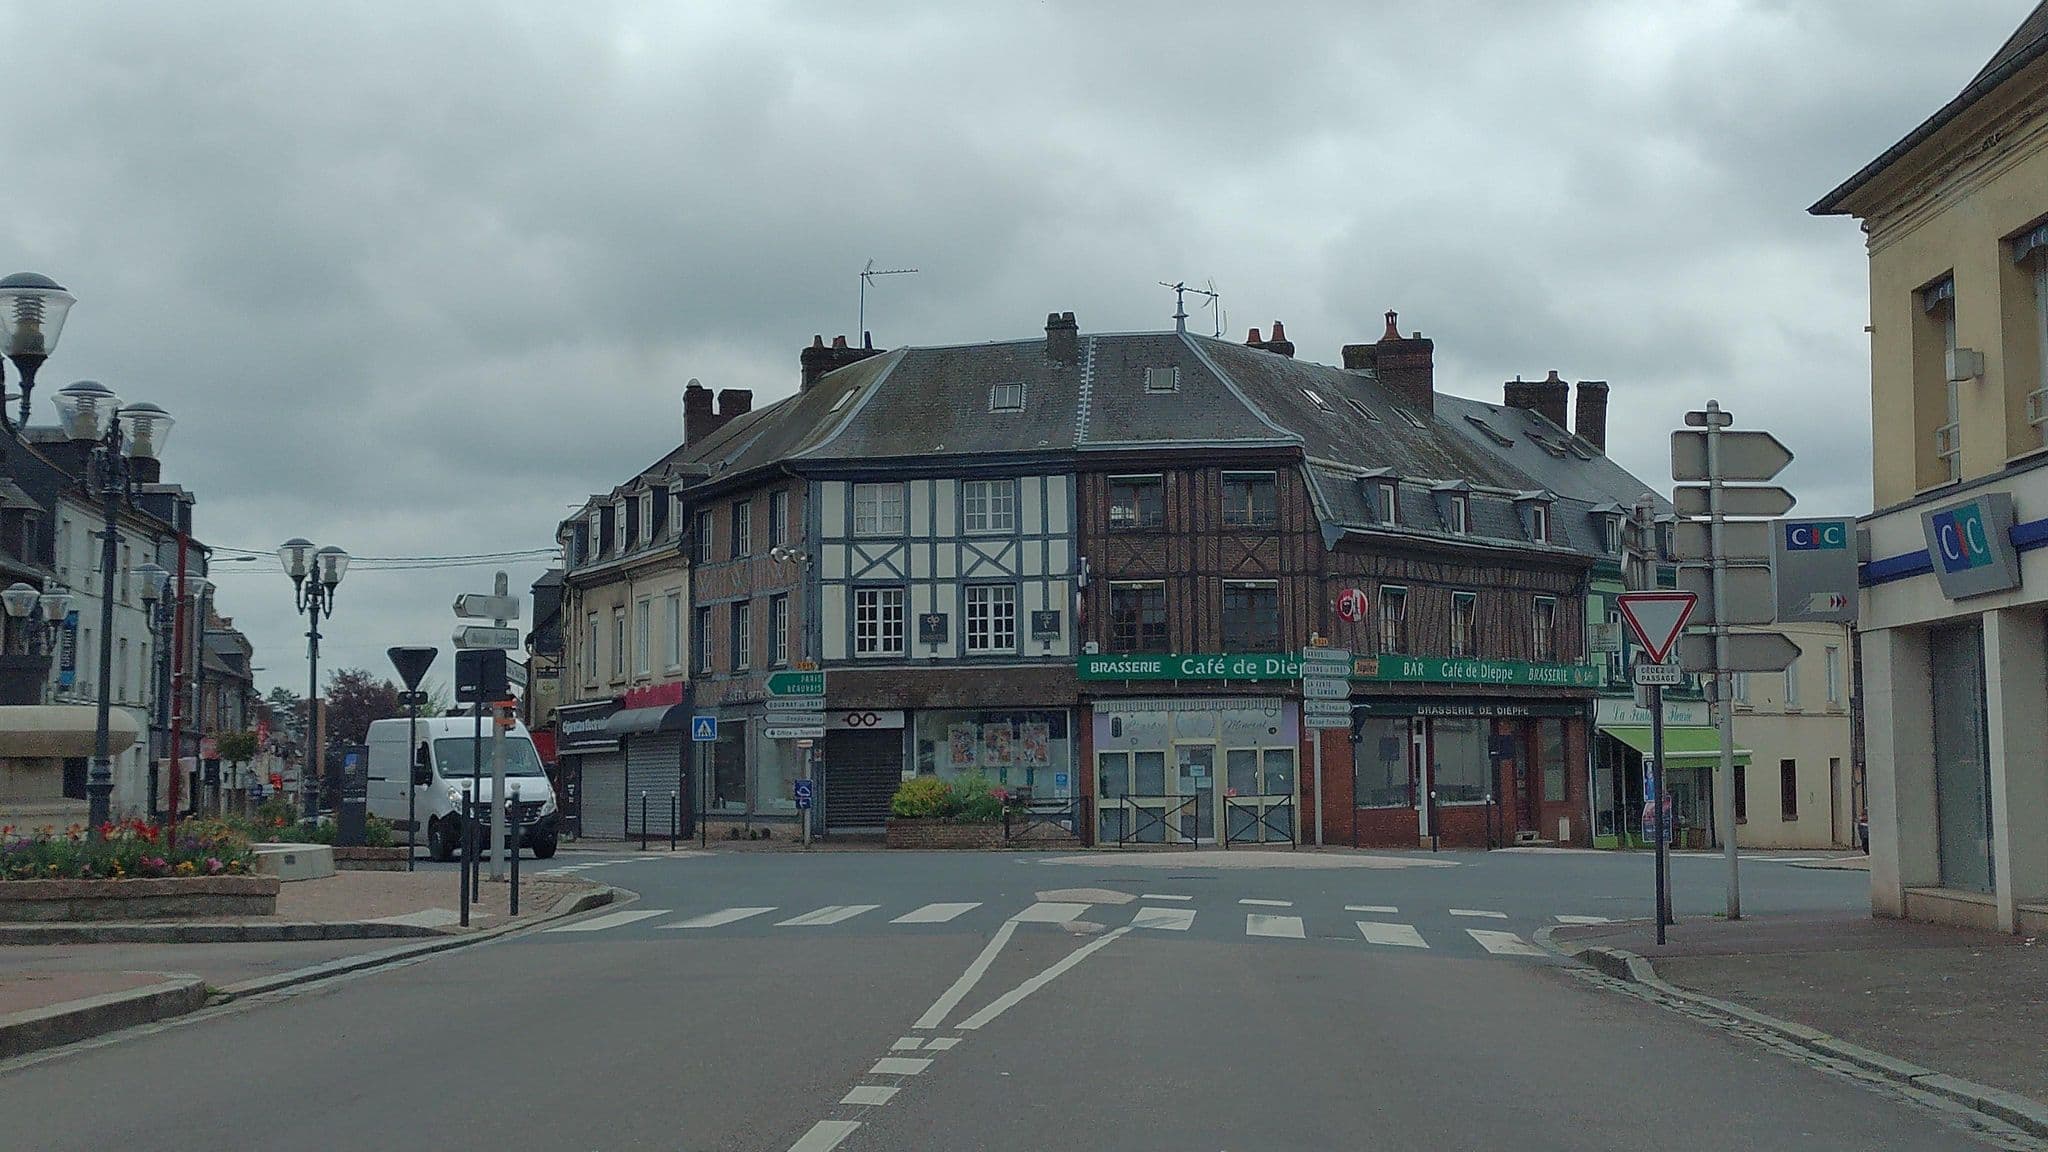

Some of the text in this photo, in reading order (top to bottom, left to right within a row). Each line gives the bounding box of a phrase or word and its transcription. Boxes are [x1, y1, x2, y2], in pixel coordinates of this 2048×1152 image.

[1791, 527, 1839, 546] CIC
[1941, 517, 1983, 560] CIC
[1090, 658, 1304, 679] BRASSERIE Café de Die
[1403, 662, 1424, 676] BAR
[1441, 662, 1463, 678] Café
[1466, 664, 1477, 678] de
[1481, 664, 1513, 682] Dieppe
[1528, 667, 1568, 682] BRASSERIE
[801, 674, 822, 683] PARIS
[787, 684, 822, 693] BEAUVAIS
[1417, 706, 1530, 716] BRASSERIE DE DIEPPE
